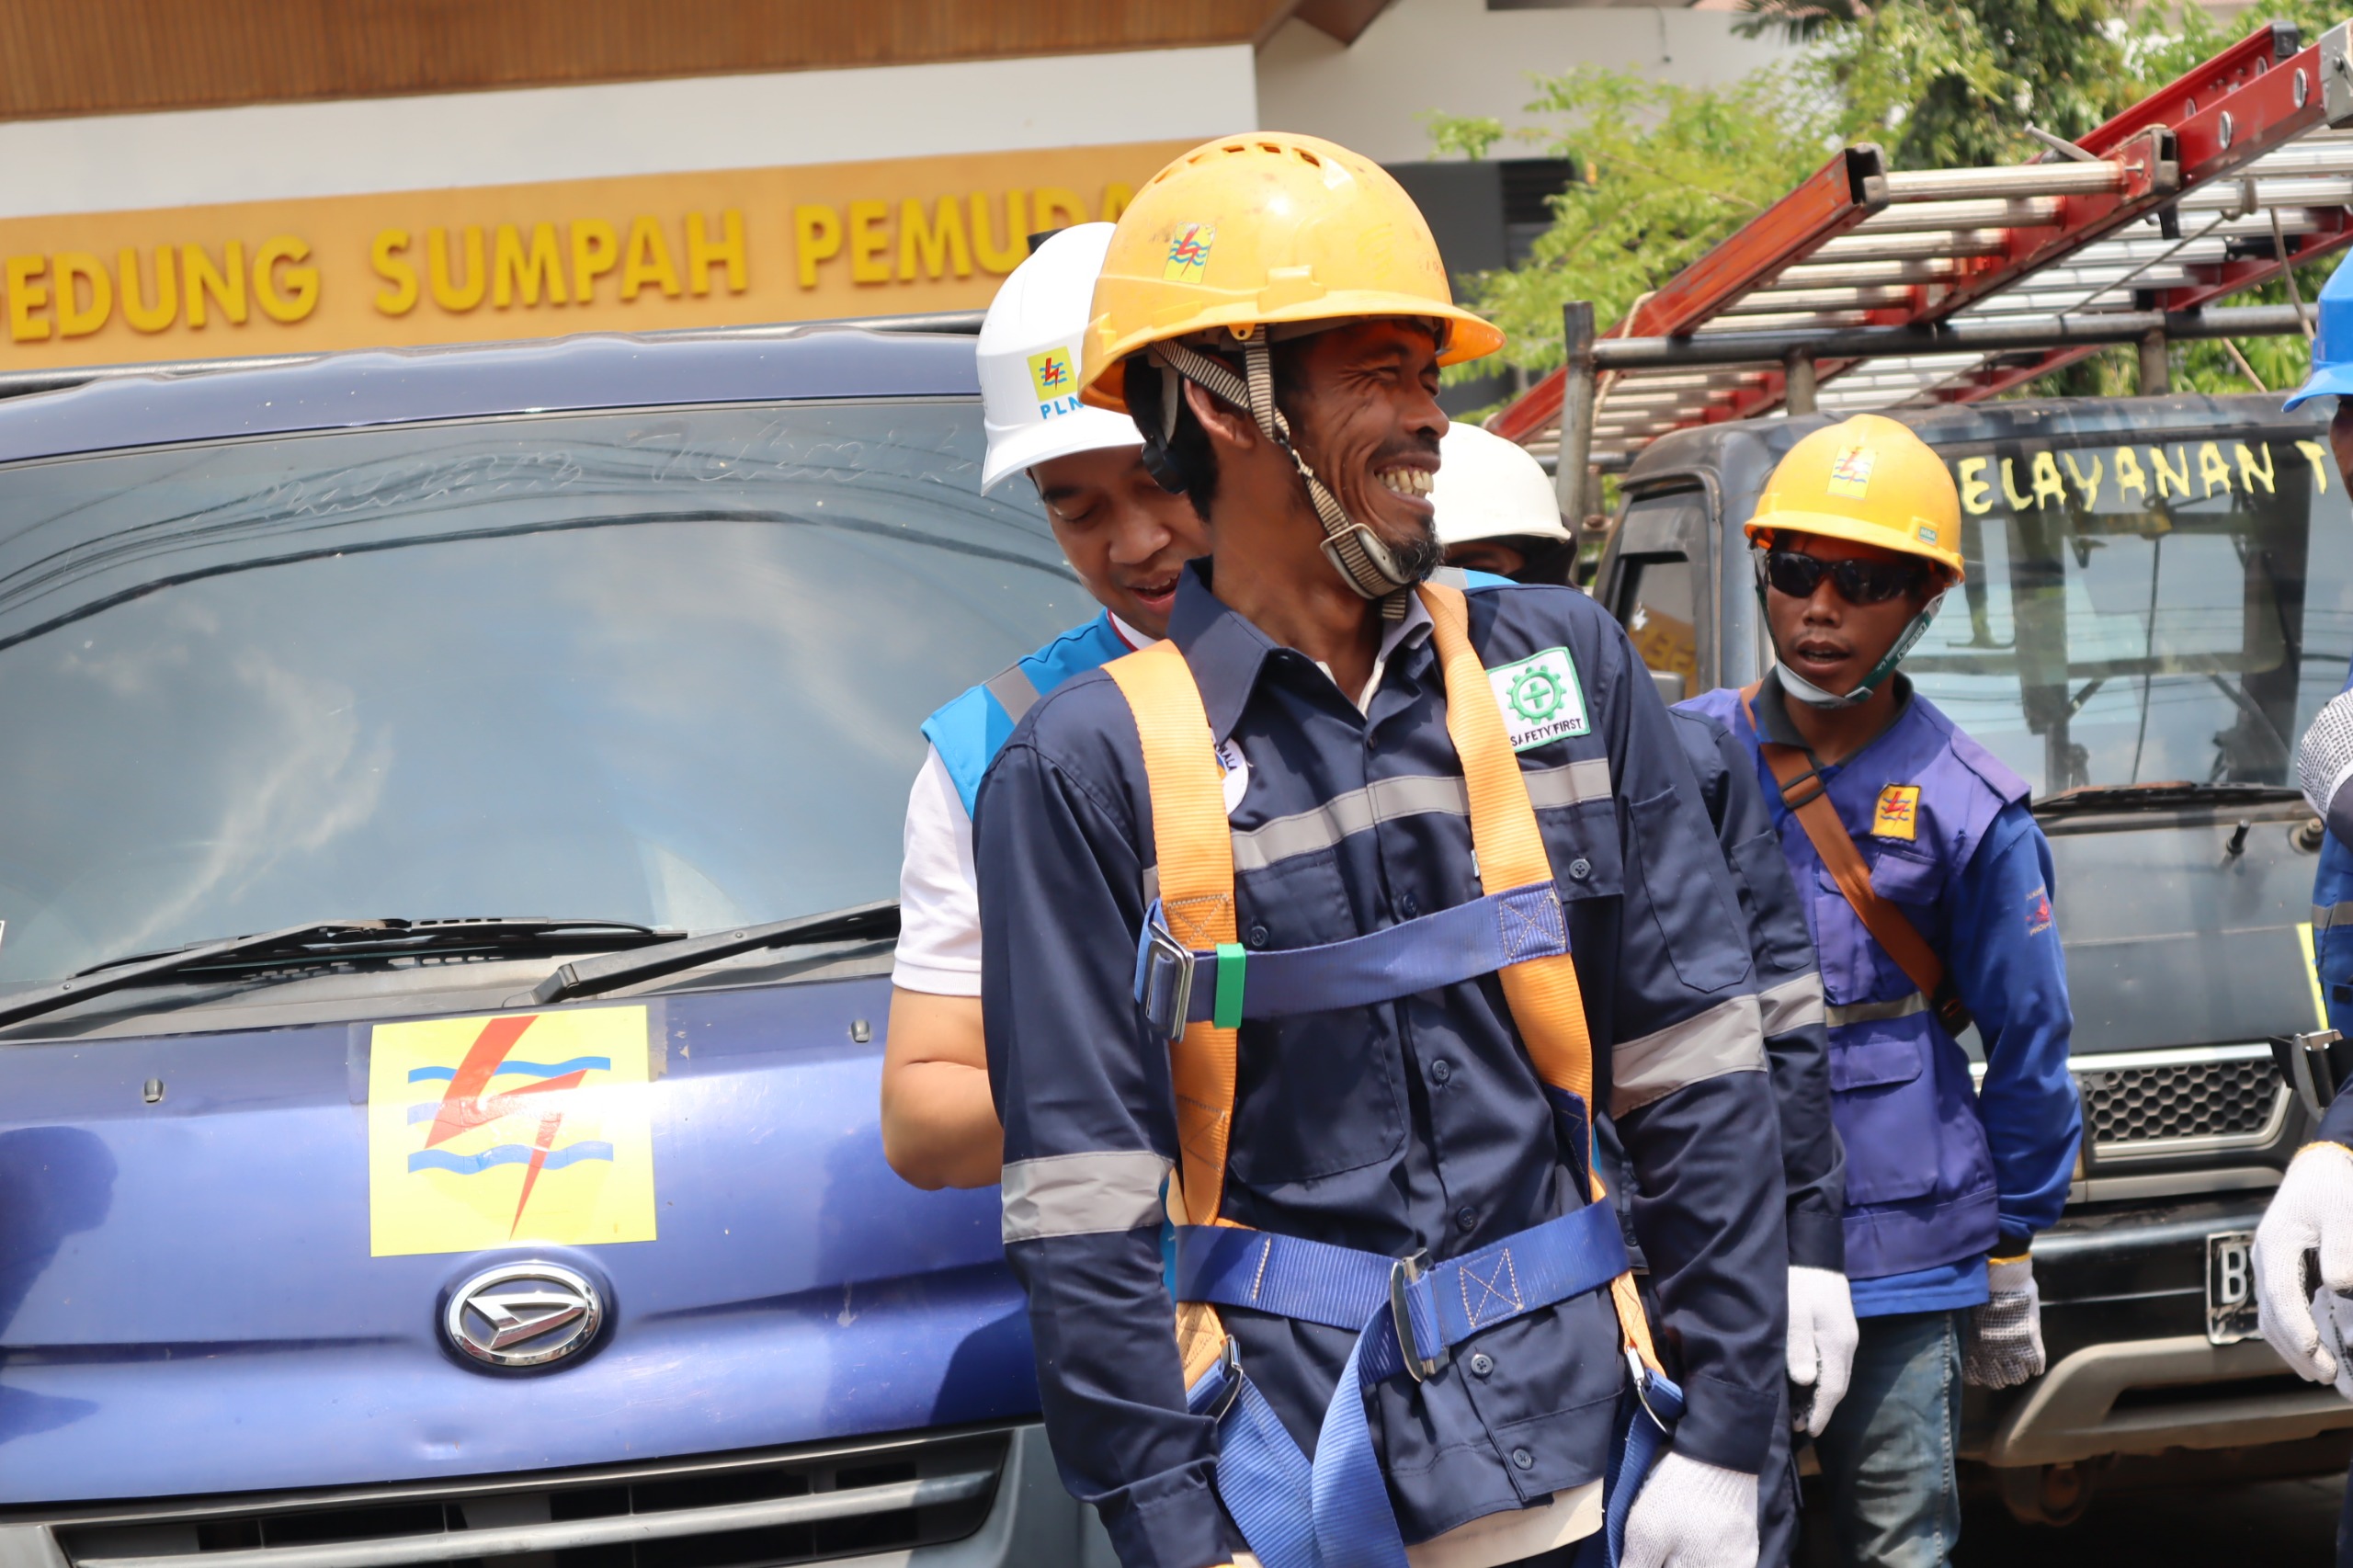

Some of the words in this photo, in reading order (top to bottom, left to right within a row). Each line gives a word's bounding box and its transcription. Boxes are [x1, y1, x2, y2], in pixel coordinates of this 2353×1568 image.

[0, 233, 319, 343] EDUNG
[370, 207, 748, 317] SUMPAH
[1959, 440, 2276, 515] ELAYANAN
[1510, 724, 1552, 747] SAFETY
[1552, 718, 1582, 735] FIRST
[2221, 1245, 2247, 1304] B
